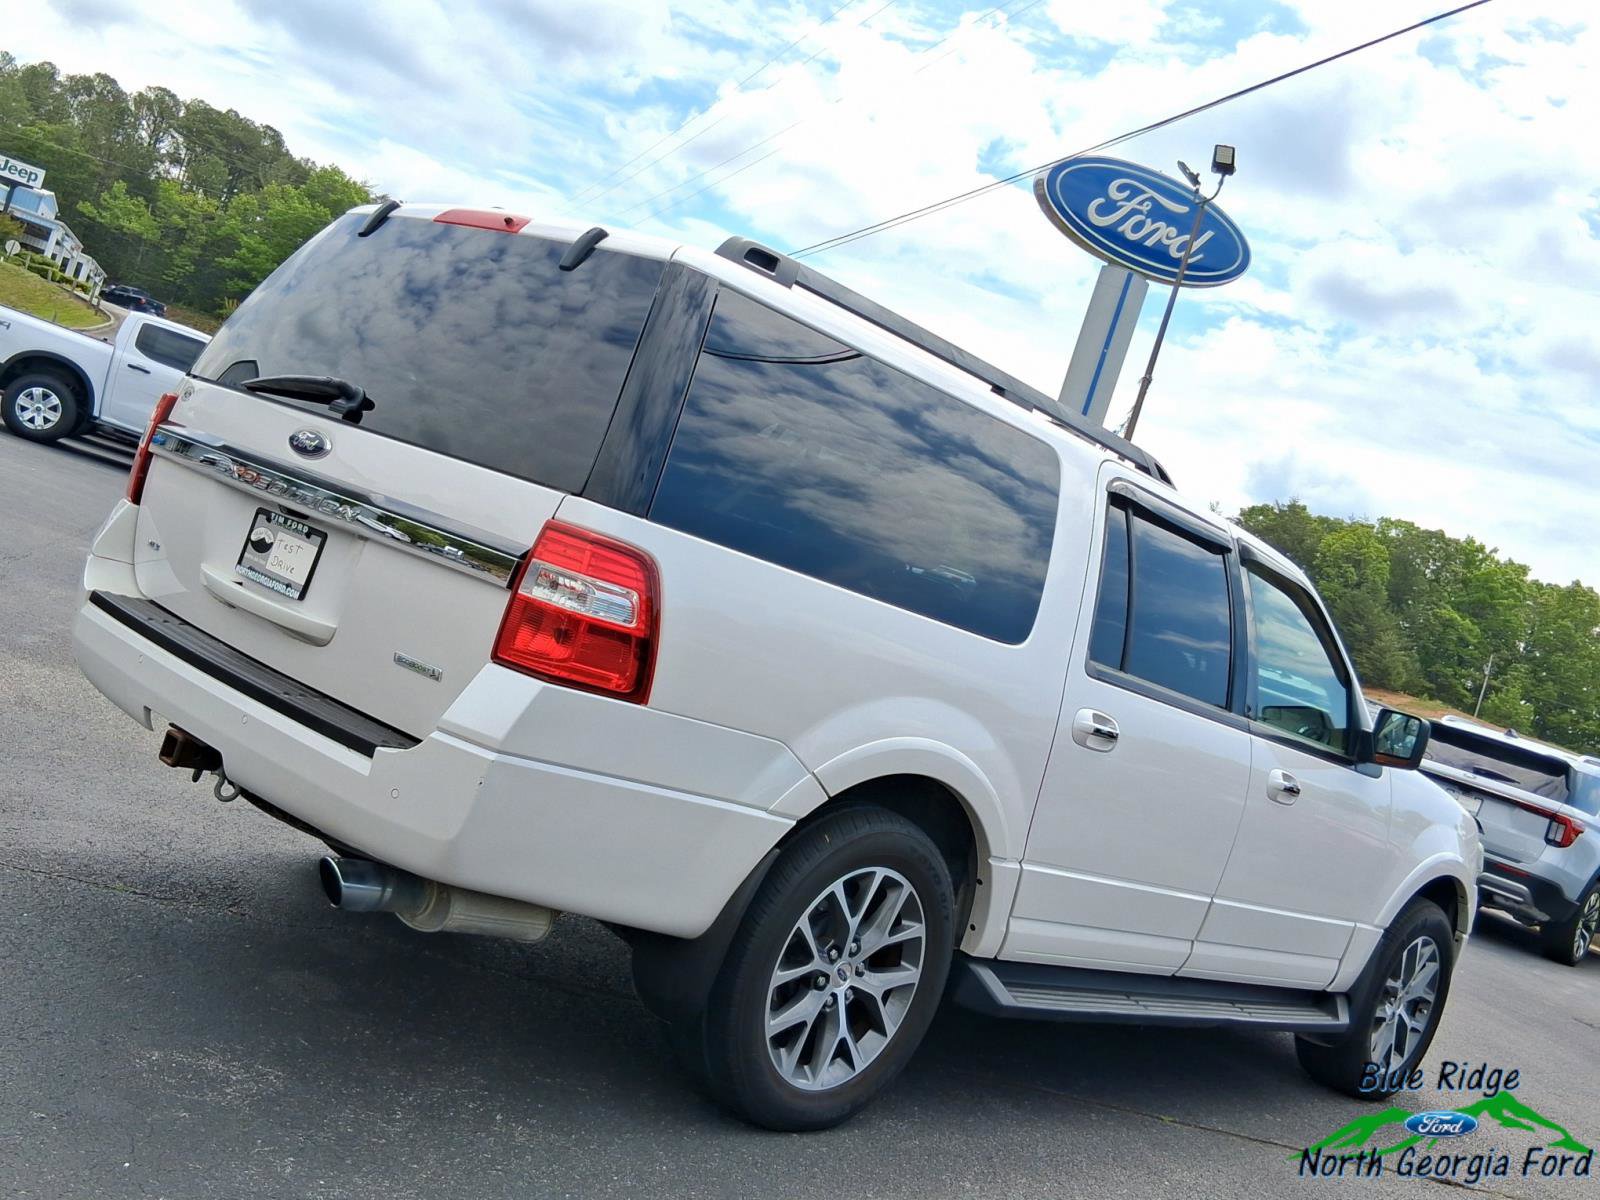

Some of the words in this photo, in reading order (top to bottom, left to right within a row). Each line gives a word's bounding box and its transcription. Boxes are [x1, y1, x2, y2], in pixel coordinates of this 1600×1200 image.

[0, 159, 38, 183] Jeep
[1087, 178, 1215, 264] Ford
[271, 512, 285, 524] TIM
[287, 520, 309, 533] FORD
